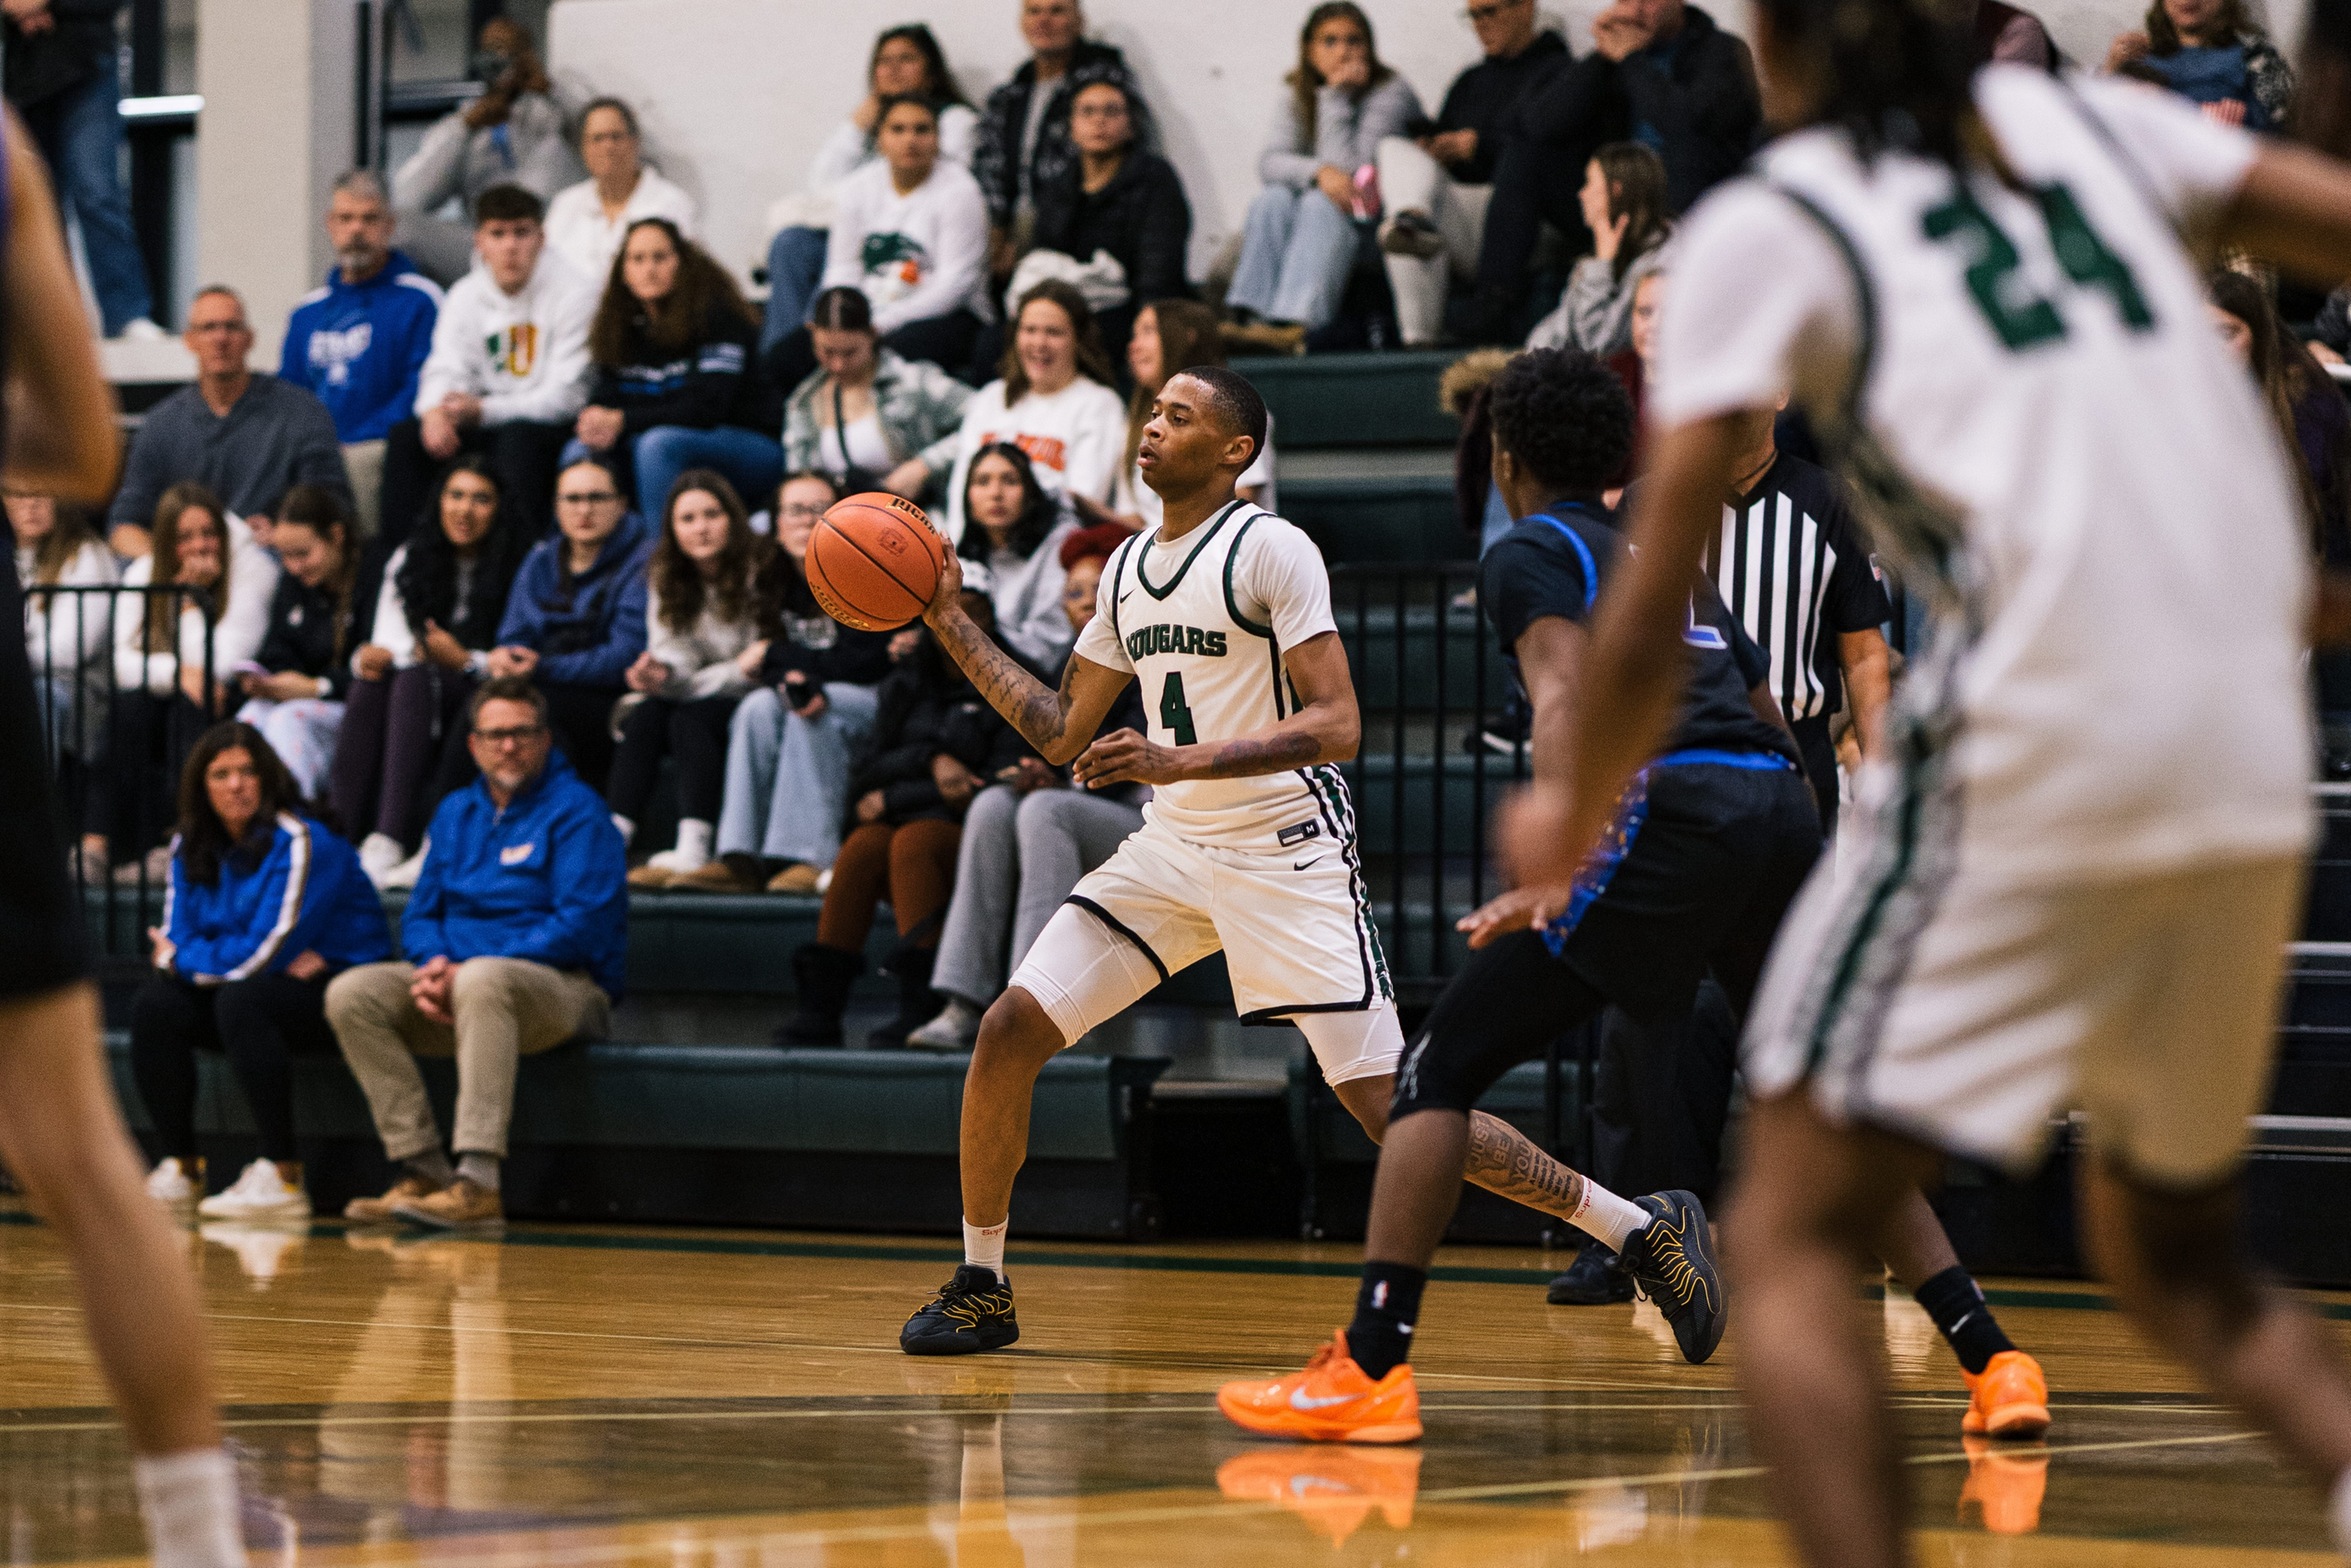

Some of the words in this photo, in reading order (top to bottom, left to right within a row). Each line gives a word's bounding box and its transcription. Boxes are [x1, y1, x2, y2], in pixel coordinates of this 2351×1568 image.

[1921, 180, 2156, 349] 24
[1159, 671, 1198, 747] 4
[1305, 824, 1315, 834] M
[1470, 1118, 1490, 1164] JUST
[1493, 1139, 1510, 1164] BE
[1511, 1142, 1531, 1180] YOU
[1575, 1180, 1592, 1219] Supre
[981, 1226, 1005, 1236] Supr
